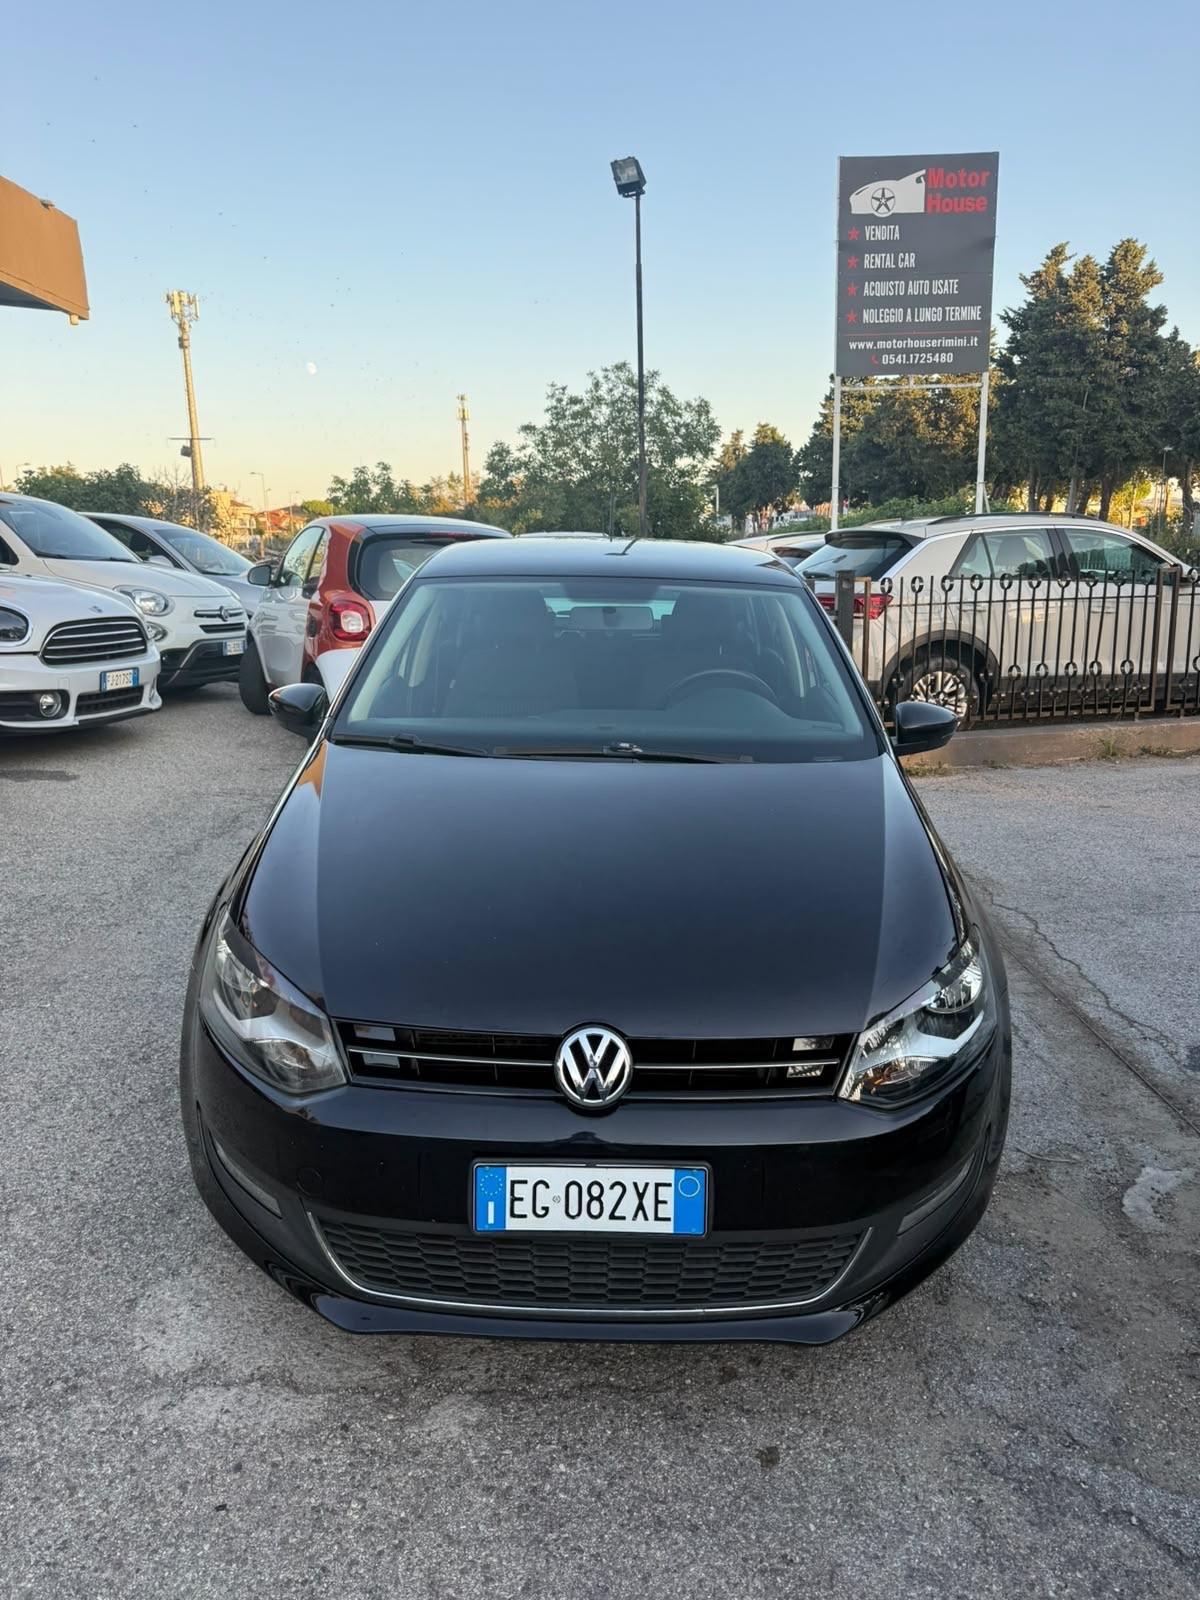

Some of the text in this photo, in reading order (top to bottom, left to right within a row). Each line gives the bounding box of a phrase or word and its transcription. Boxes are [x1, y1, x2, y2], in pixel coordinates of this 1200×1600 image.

[927, 168, 990, 188] Motor
[926, 193, 988, 213] House
[865, 225, 900, 240] VENDITA
[864, 252, 916, 269] RENTAL CAR
[863, 279, 959, 296] ACQUISTO AUTO USATE
[862, 305, 982, 323] NOLEGGIO A LUNGO TERMINE
[848, 336, 979, 350] www.motorhouserimini.it
[881, 352, 954, 365] 0541.1725480
